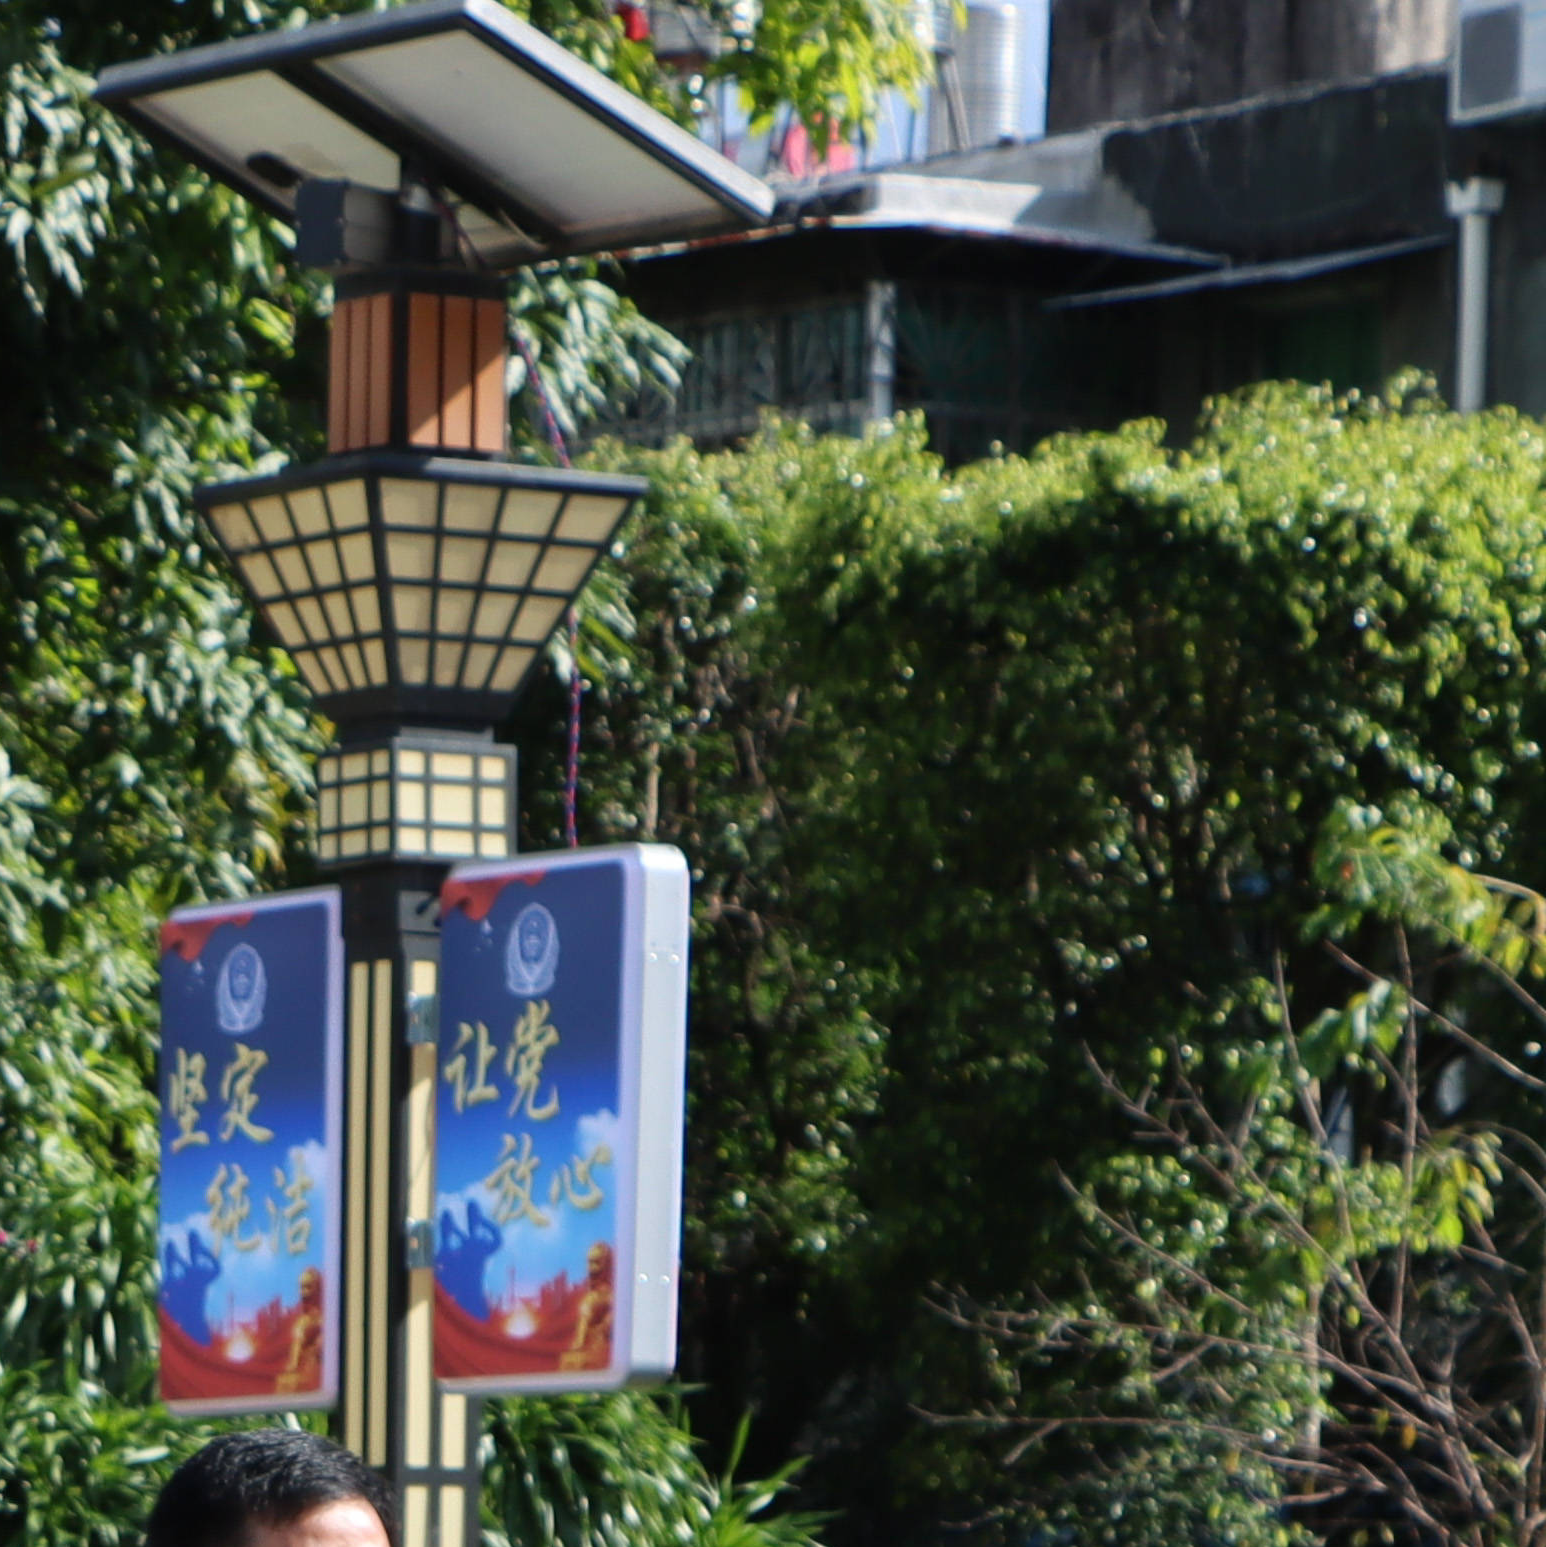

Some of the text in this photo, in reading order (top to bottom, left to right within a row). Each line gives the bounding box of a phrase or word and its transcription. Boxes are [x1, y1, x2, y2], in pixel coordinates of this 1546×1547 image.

[169, 1042, 274, 1154] 坚定
[444, 999, 560, 1121] 让党
[206, 1147, 314, 1259] 纯洁
[485, 1132, 613, 1227] 放心
